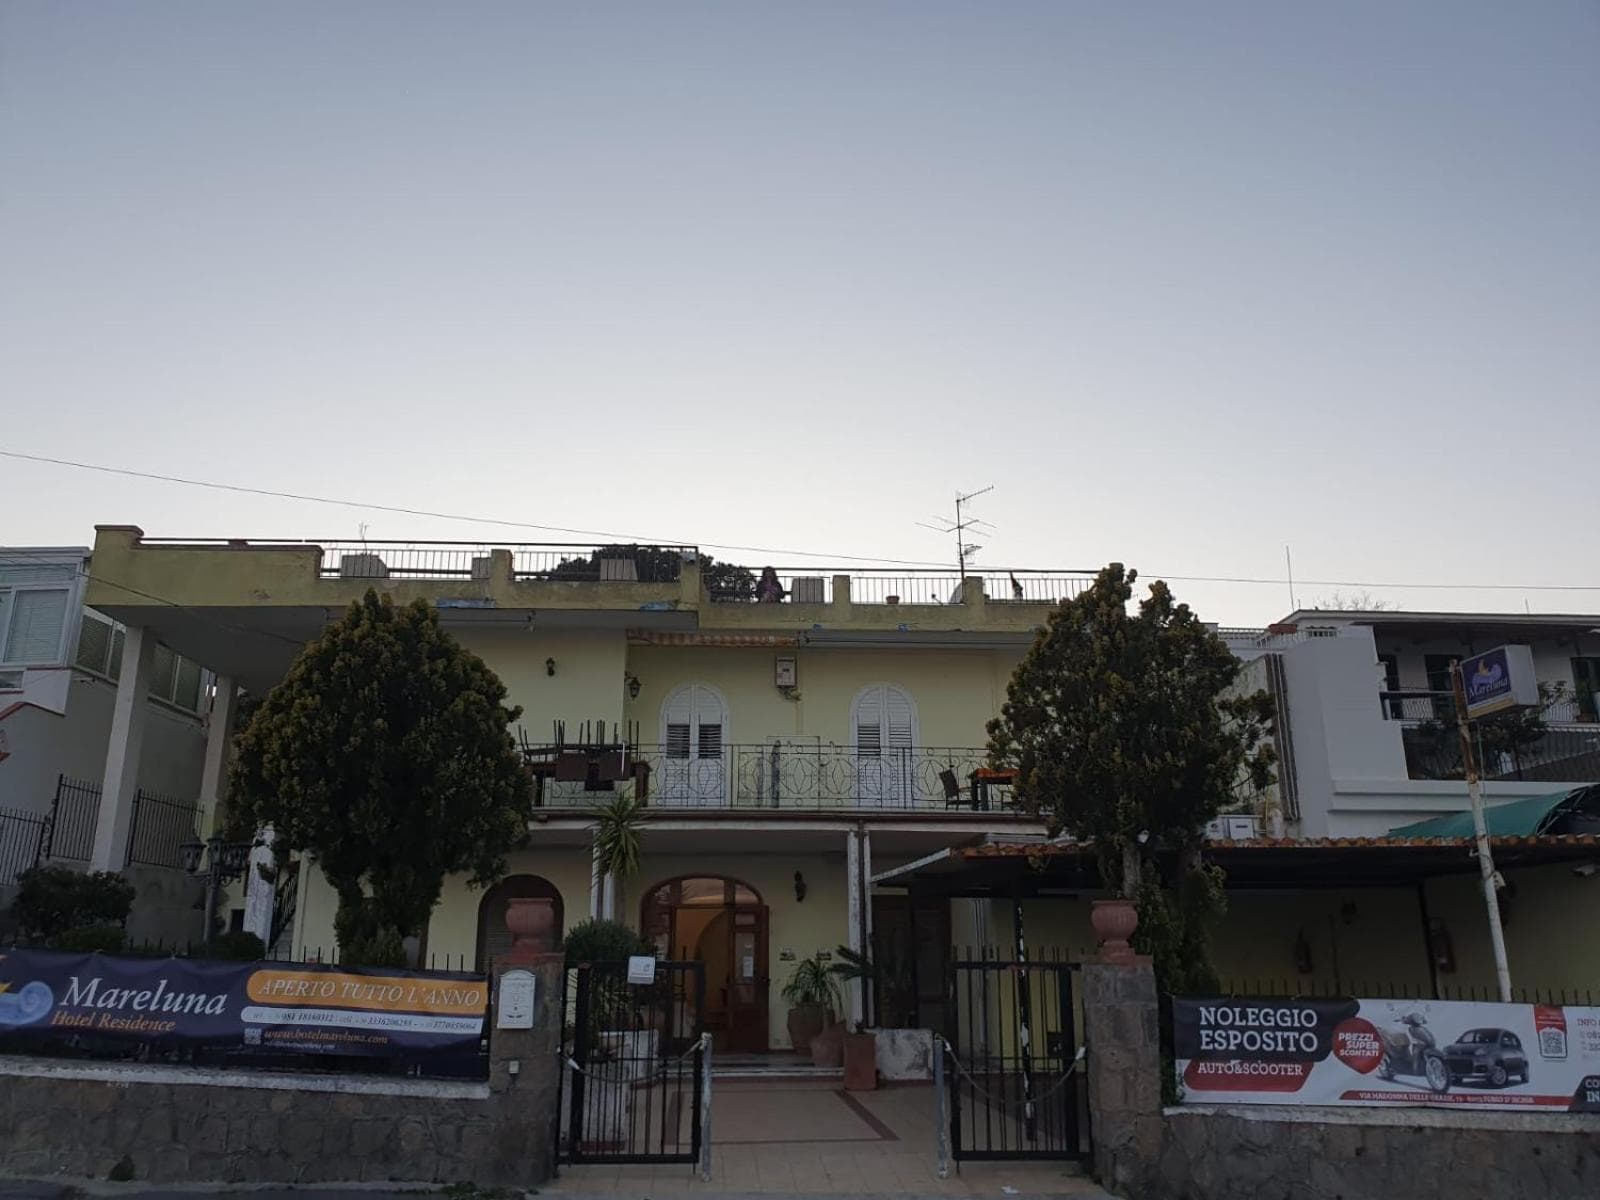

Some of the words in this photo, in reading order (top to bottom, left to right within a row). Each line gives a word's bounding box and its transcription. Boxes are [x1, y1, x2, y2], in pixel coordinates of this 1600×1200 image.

[60, 976, 228, 1016] Mareluna
[258, 979, 336, 997] APERTO
[342, 982, 402, 1002] TUTTO
[407, 986, 480, 1006] L'ANNO
[52, 1011, 96, 1029] Hotel
[100, 1014, 176, 1032] Residence
[1200, 1007, 1318, 1028] NOLEGGIO
[1200, 1029, 1318, 1052] ESPOSITO
[1339, 1032, 1374, 1042] PREZZI
[1347, 1040, 1380, 1050] SUPER
[1340, 1049, 1379, 1057] SCONTATI
[1198, 1062, 1304, 1076] AUTO&SCOOTER
